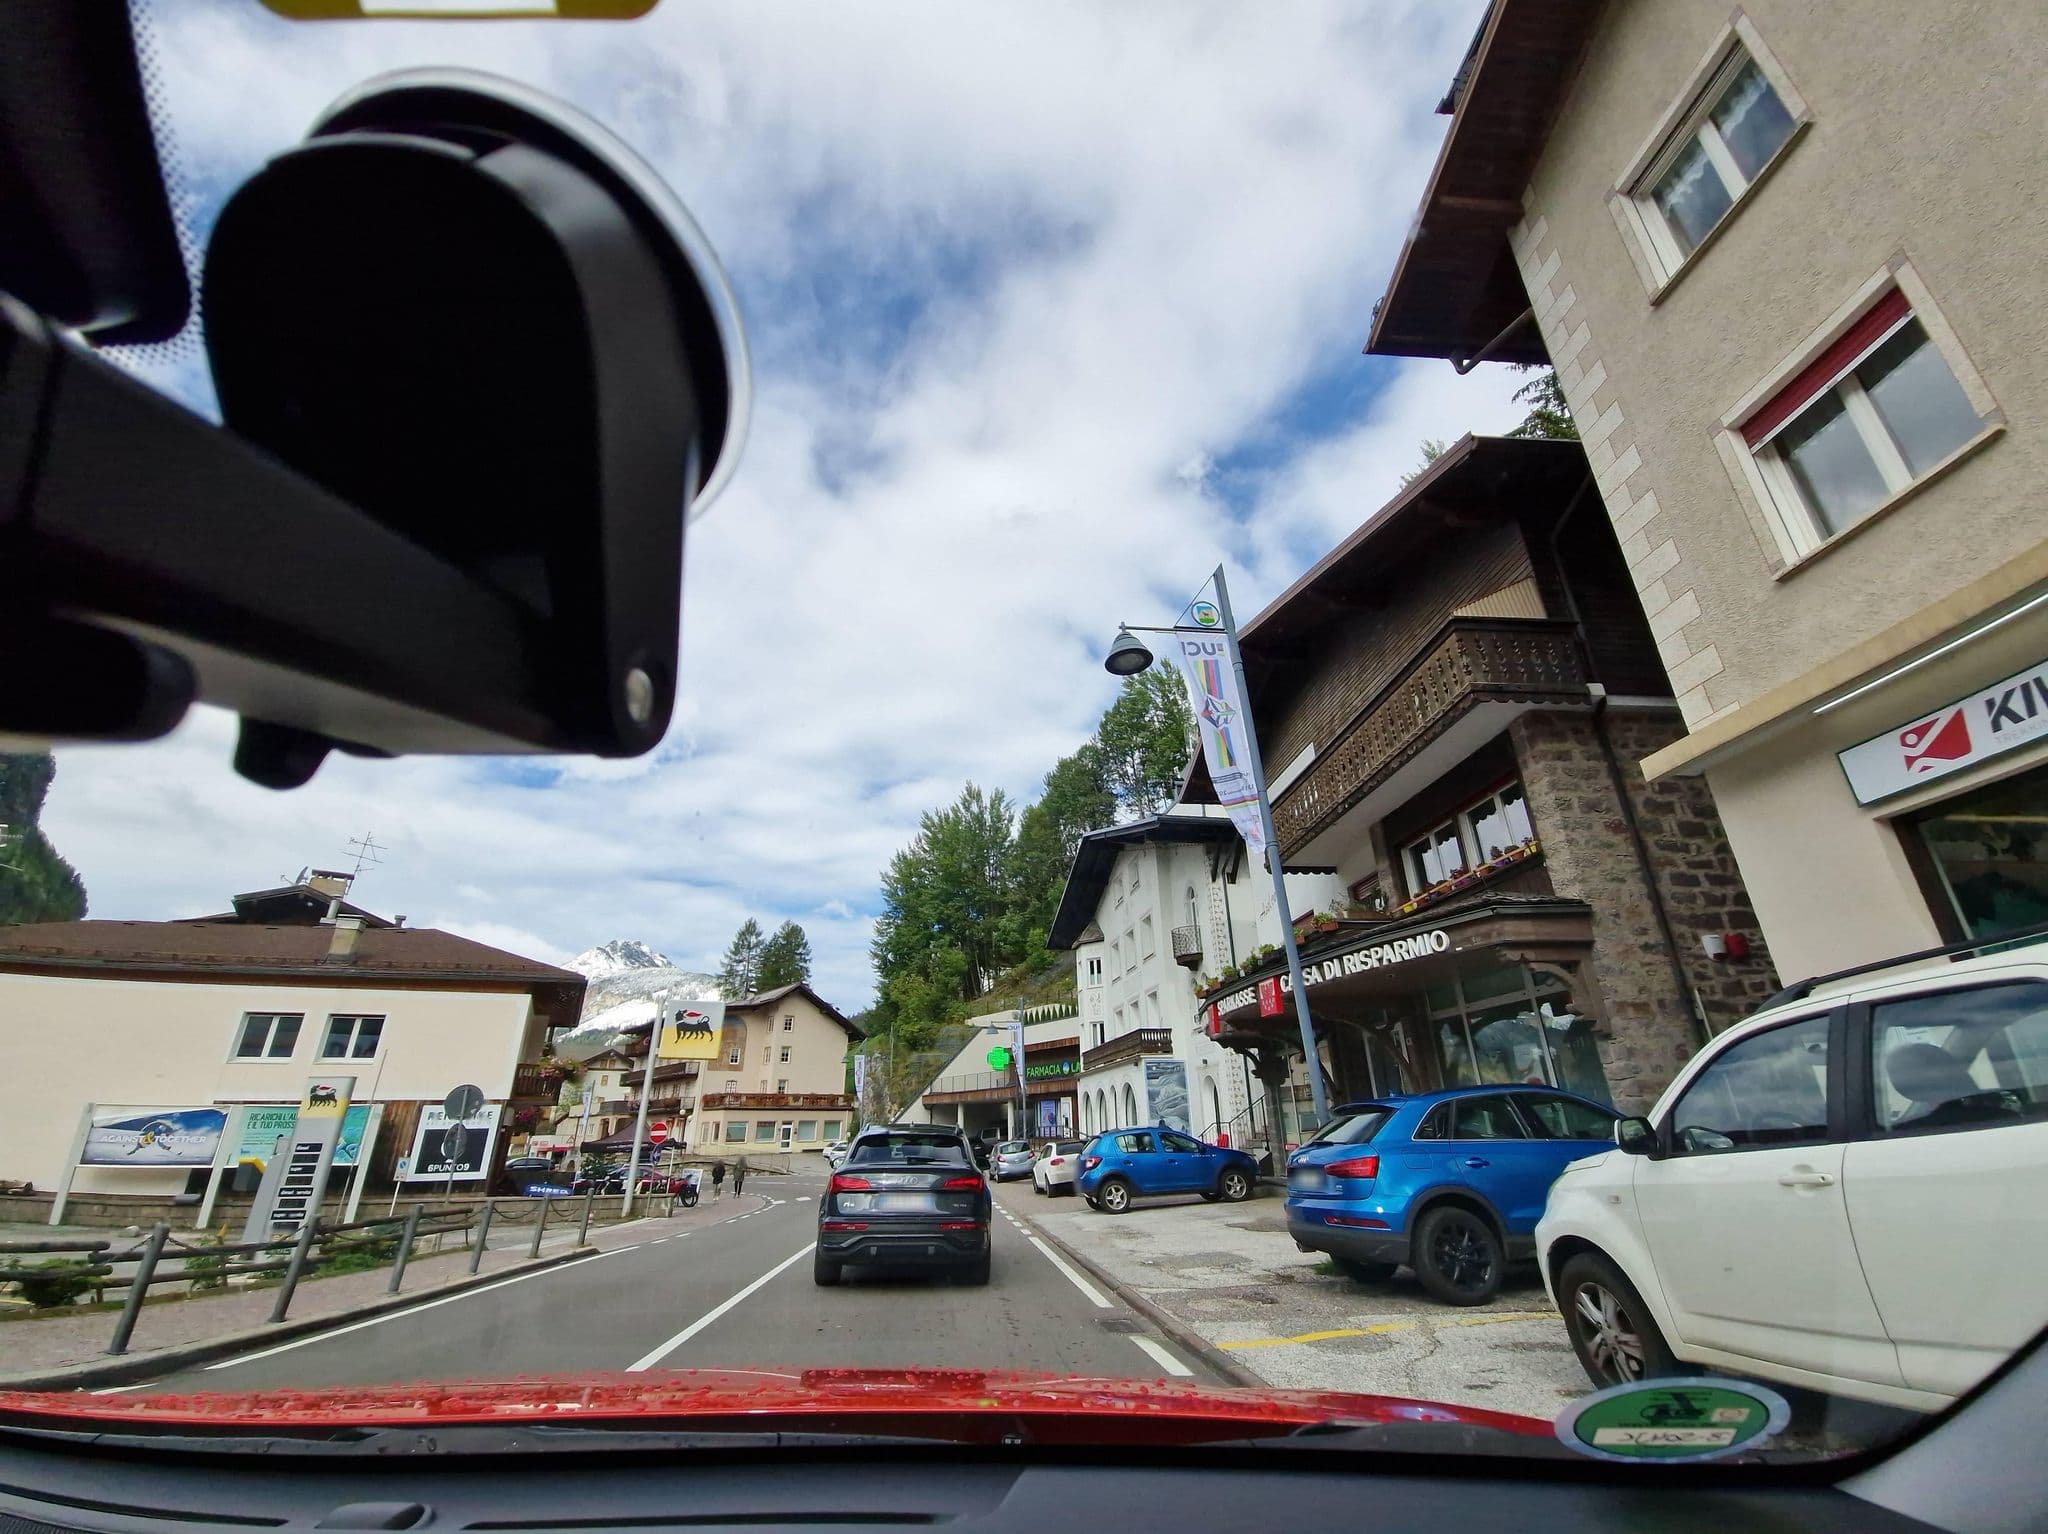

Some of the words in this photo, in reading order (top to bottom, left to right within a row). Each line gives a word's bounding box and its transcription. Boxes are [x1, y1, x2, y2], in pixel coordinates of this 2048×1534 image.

[1323, 961, 1342, 980] DI
[1343, 930, 1450, 974] RISPARMIO
[1217, 986, 1257, 1016] SPARKASSE
[1026, 1064, 1060, 1078] FARMACIA
[101, 1135, 141, 1143] AGAINST
[154, 1135, 207, 1143] TOGETHER
[427, 1163, 470, 1172] 6PUNO9
